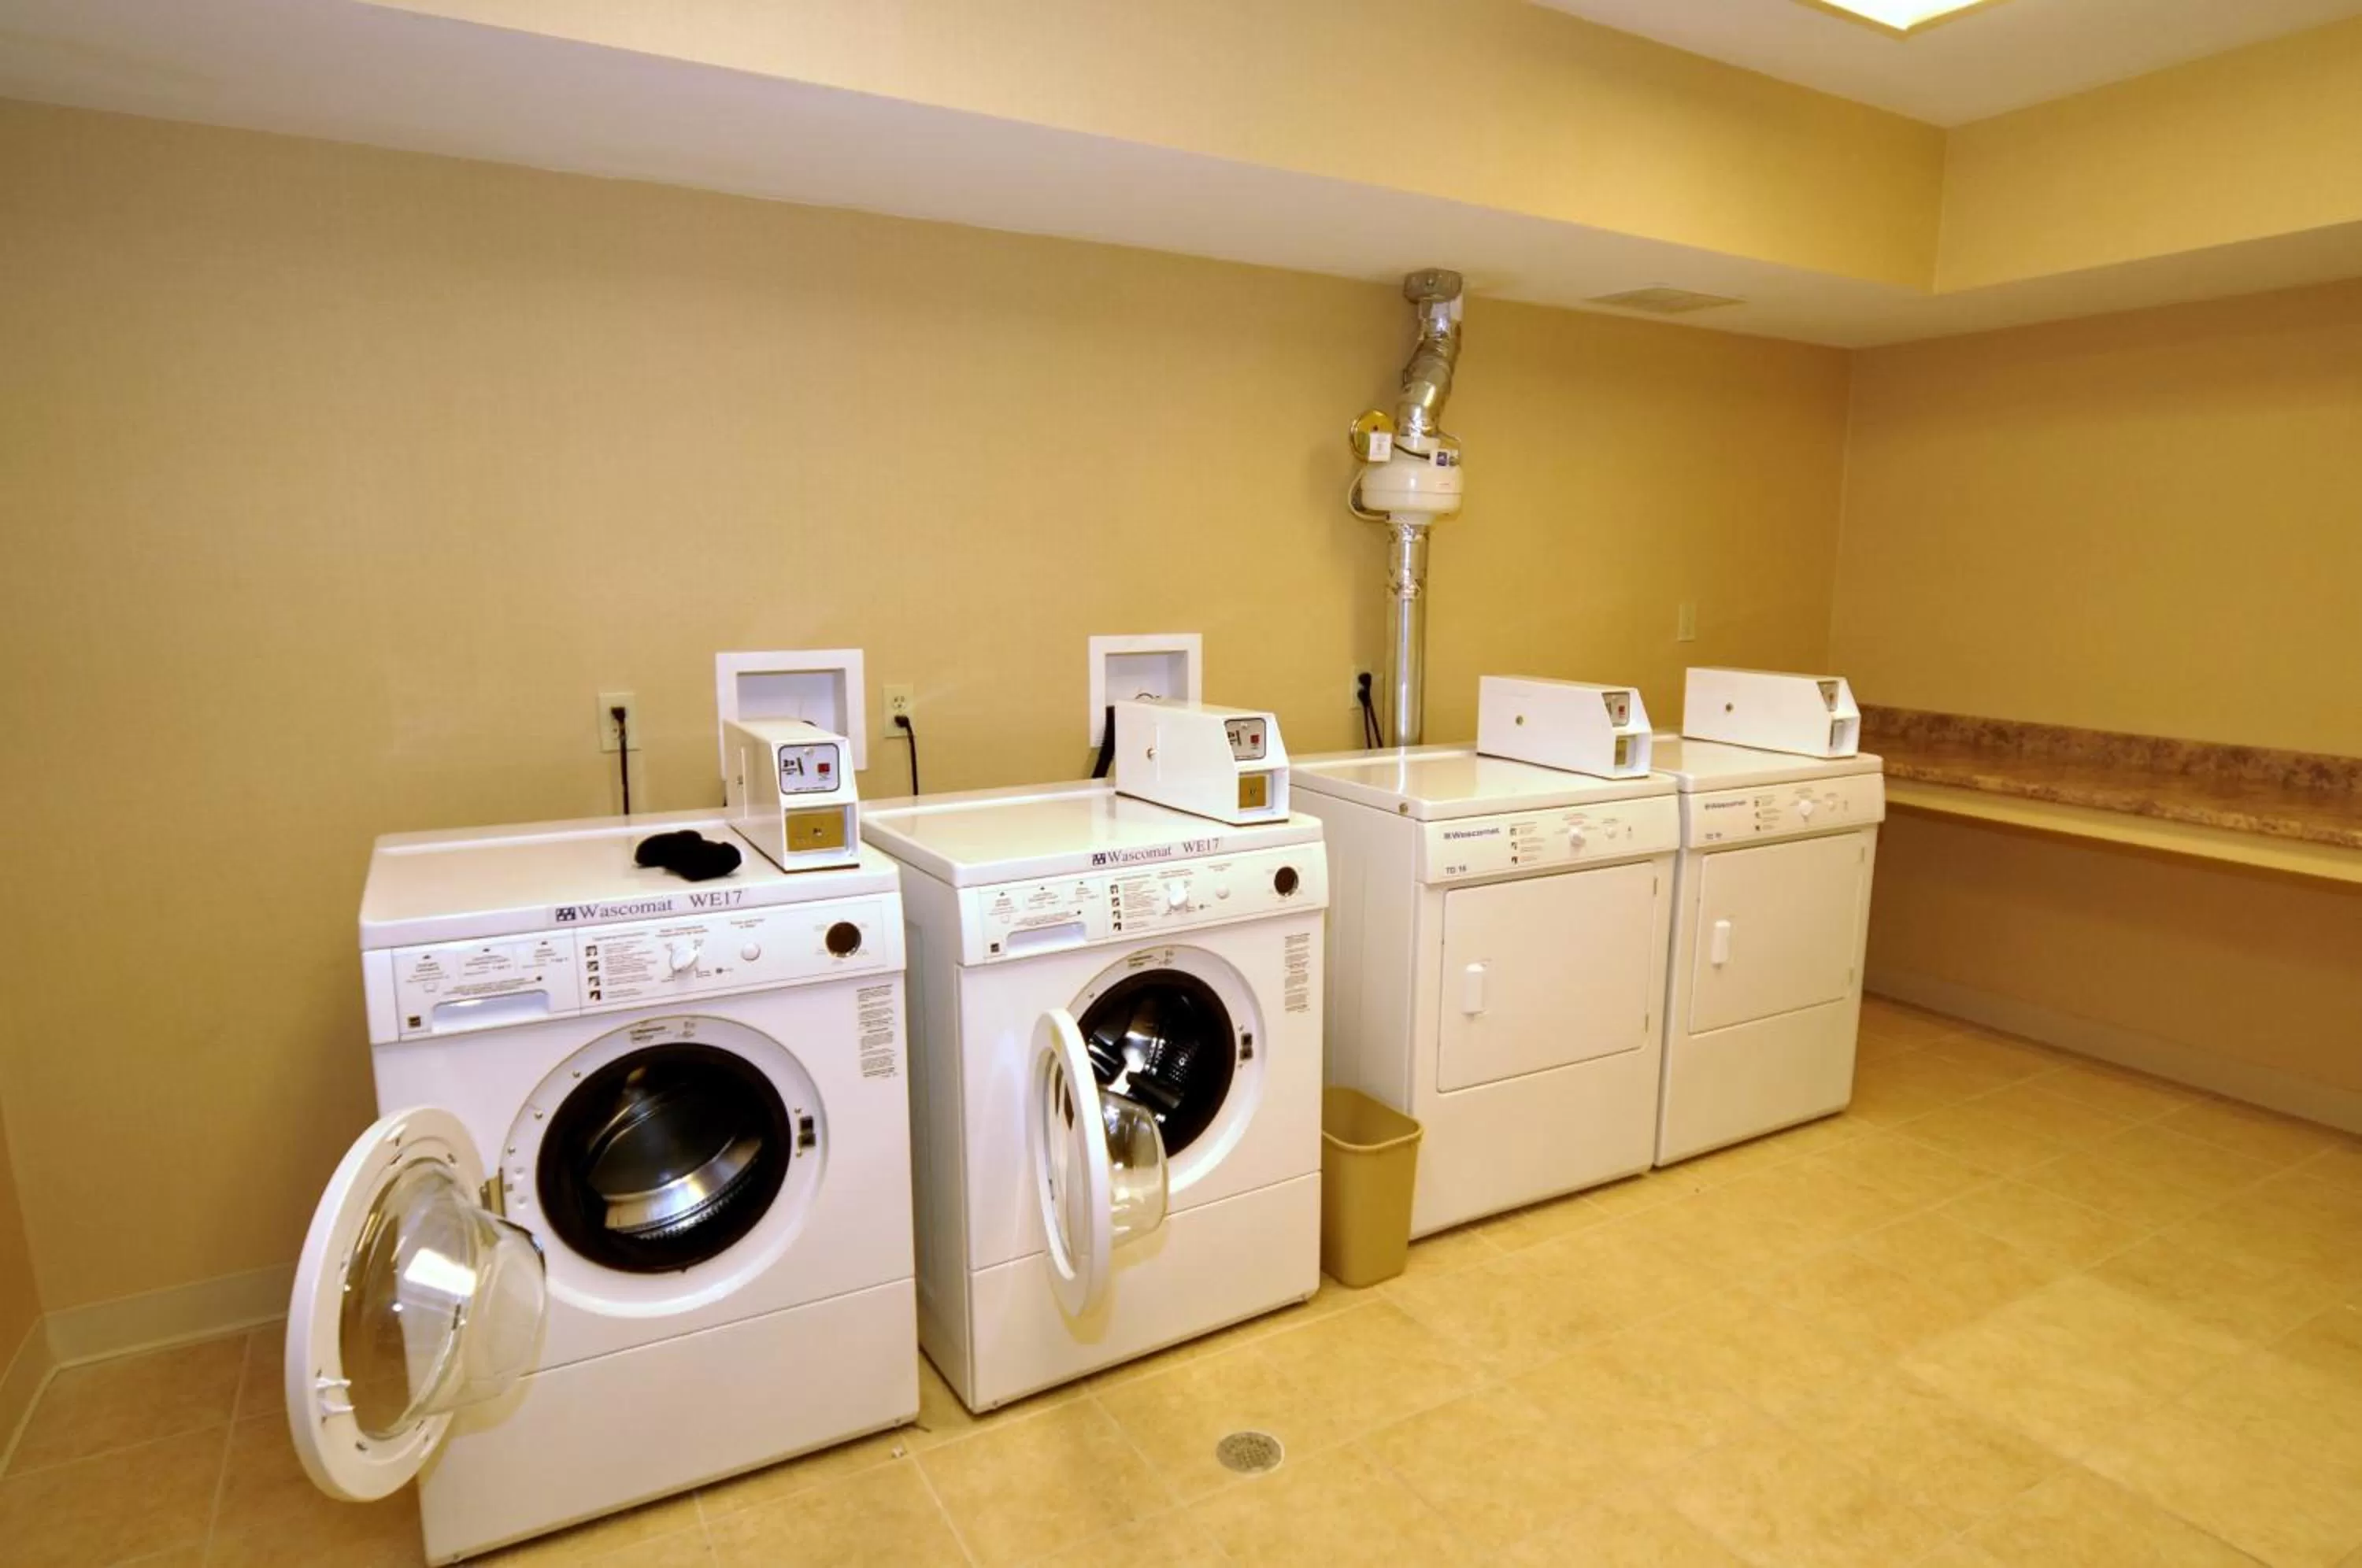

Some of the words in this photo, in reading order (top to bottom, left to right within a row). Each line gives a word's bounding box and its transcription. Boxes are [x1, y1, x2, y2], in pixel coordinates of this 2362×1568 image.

[1108, 845, 1172, 863] Wascomat
[1183, 838, 1220, 853] WE17
[579, 899, 672, 919] Wascomat
[690, 890, 742, 908] WE17
